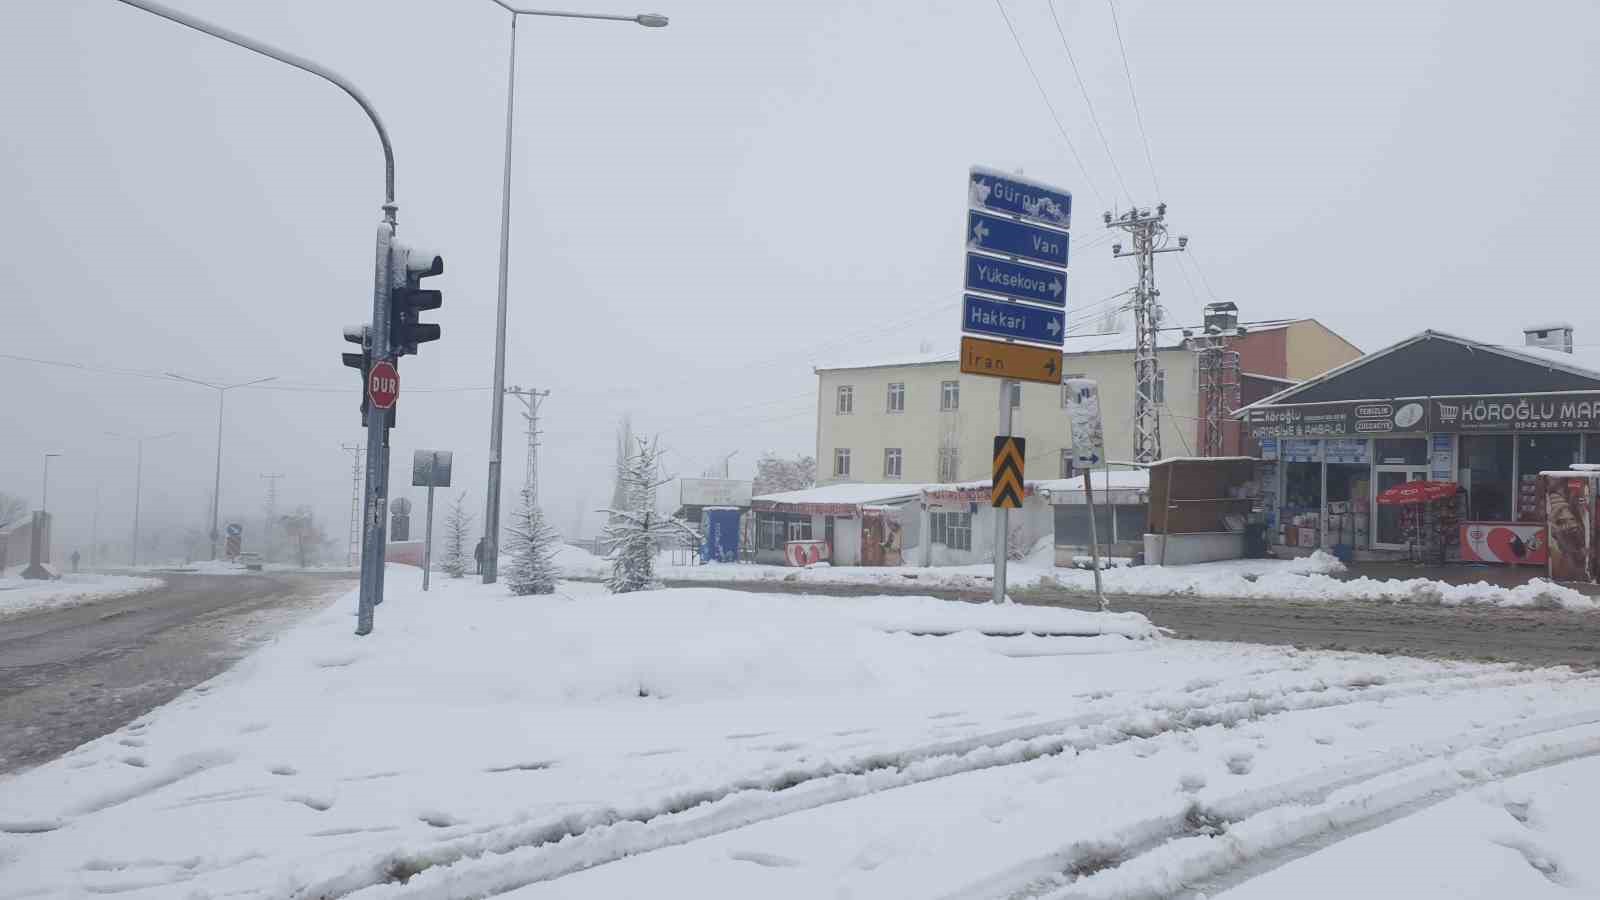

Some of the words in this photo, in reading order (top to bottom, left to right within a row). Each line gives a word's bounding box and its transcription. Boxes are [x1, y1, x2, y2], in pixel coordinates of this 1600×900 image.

[1032, 234, 1059, 255] Van
[976, 264, 1046, 293] Yüksekova
[971, 306, 1027, 331] Hakkari
[372, 376, 396, 394] DUR
[1461, 398, 1554, 420] KÖROĞLU
